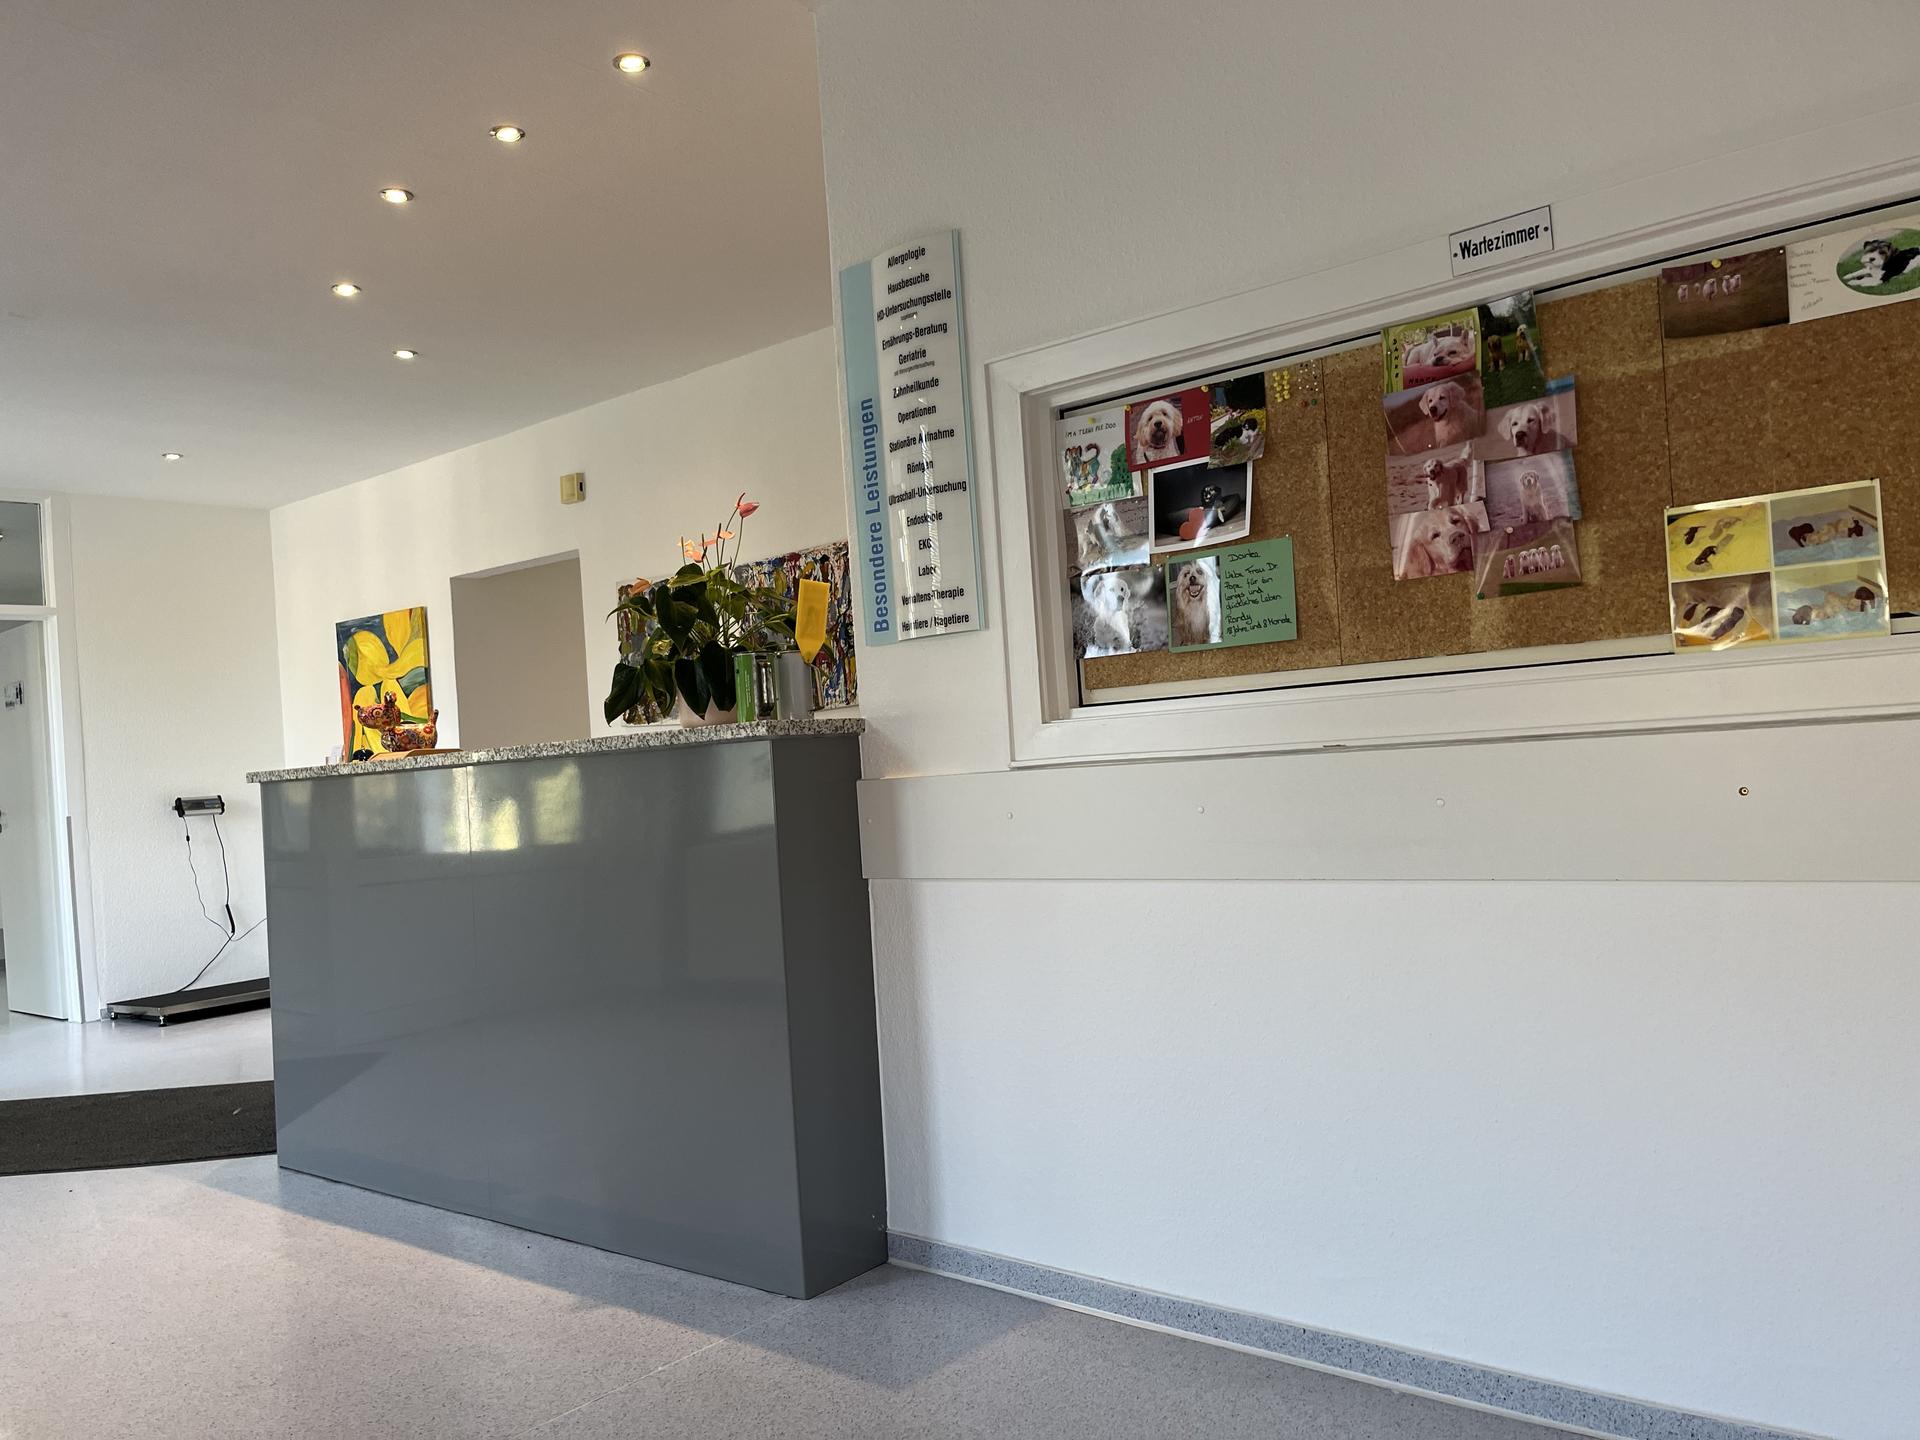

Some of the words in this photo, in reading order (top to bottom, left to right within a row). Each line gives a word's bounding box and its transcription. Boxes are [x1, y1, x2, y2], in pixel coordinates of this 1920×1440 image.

[1459, 225, 1540, 260] Wartezimmer
[888, 246, 926, 268] Allergologie
[888, 273, 930, 295] Hausbesuche
[877, 289, 952, 322] HD-Untersuchungsstelle
[882, 323, 948, 351] Ernährungs-Beratung
[899, 348, 927, 365] Geriatrie
[898, 404, 937, 424] Operationen
[889, 436, 917, 453] Stationäre
[861, 398, 881, 515] Leistungen
[918, 538, 932, 551] EKG
[869, 521, 890, 632] Besondere
[934, 613, 970, 627] Nagetiere
